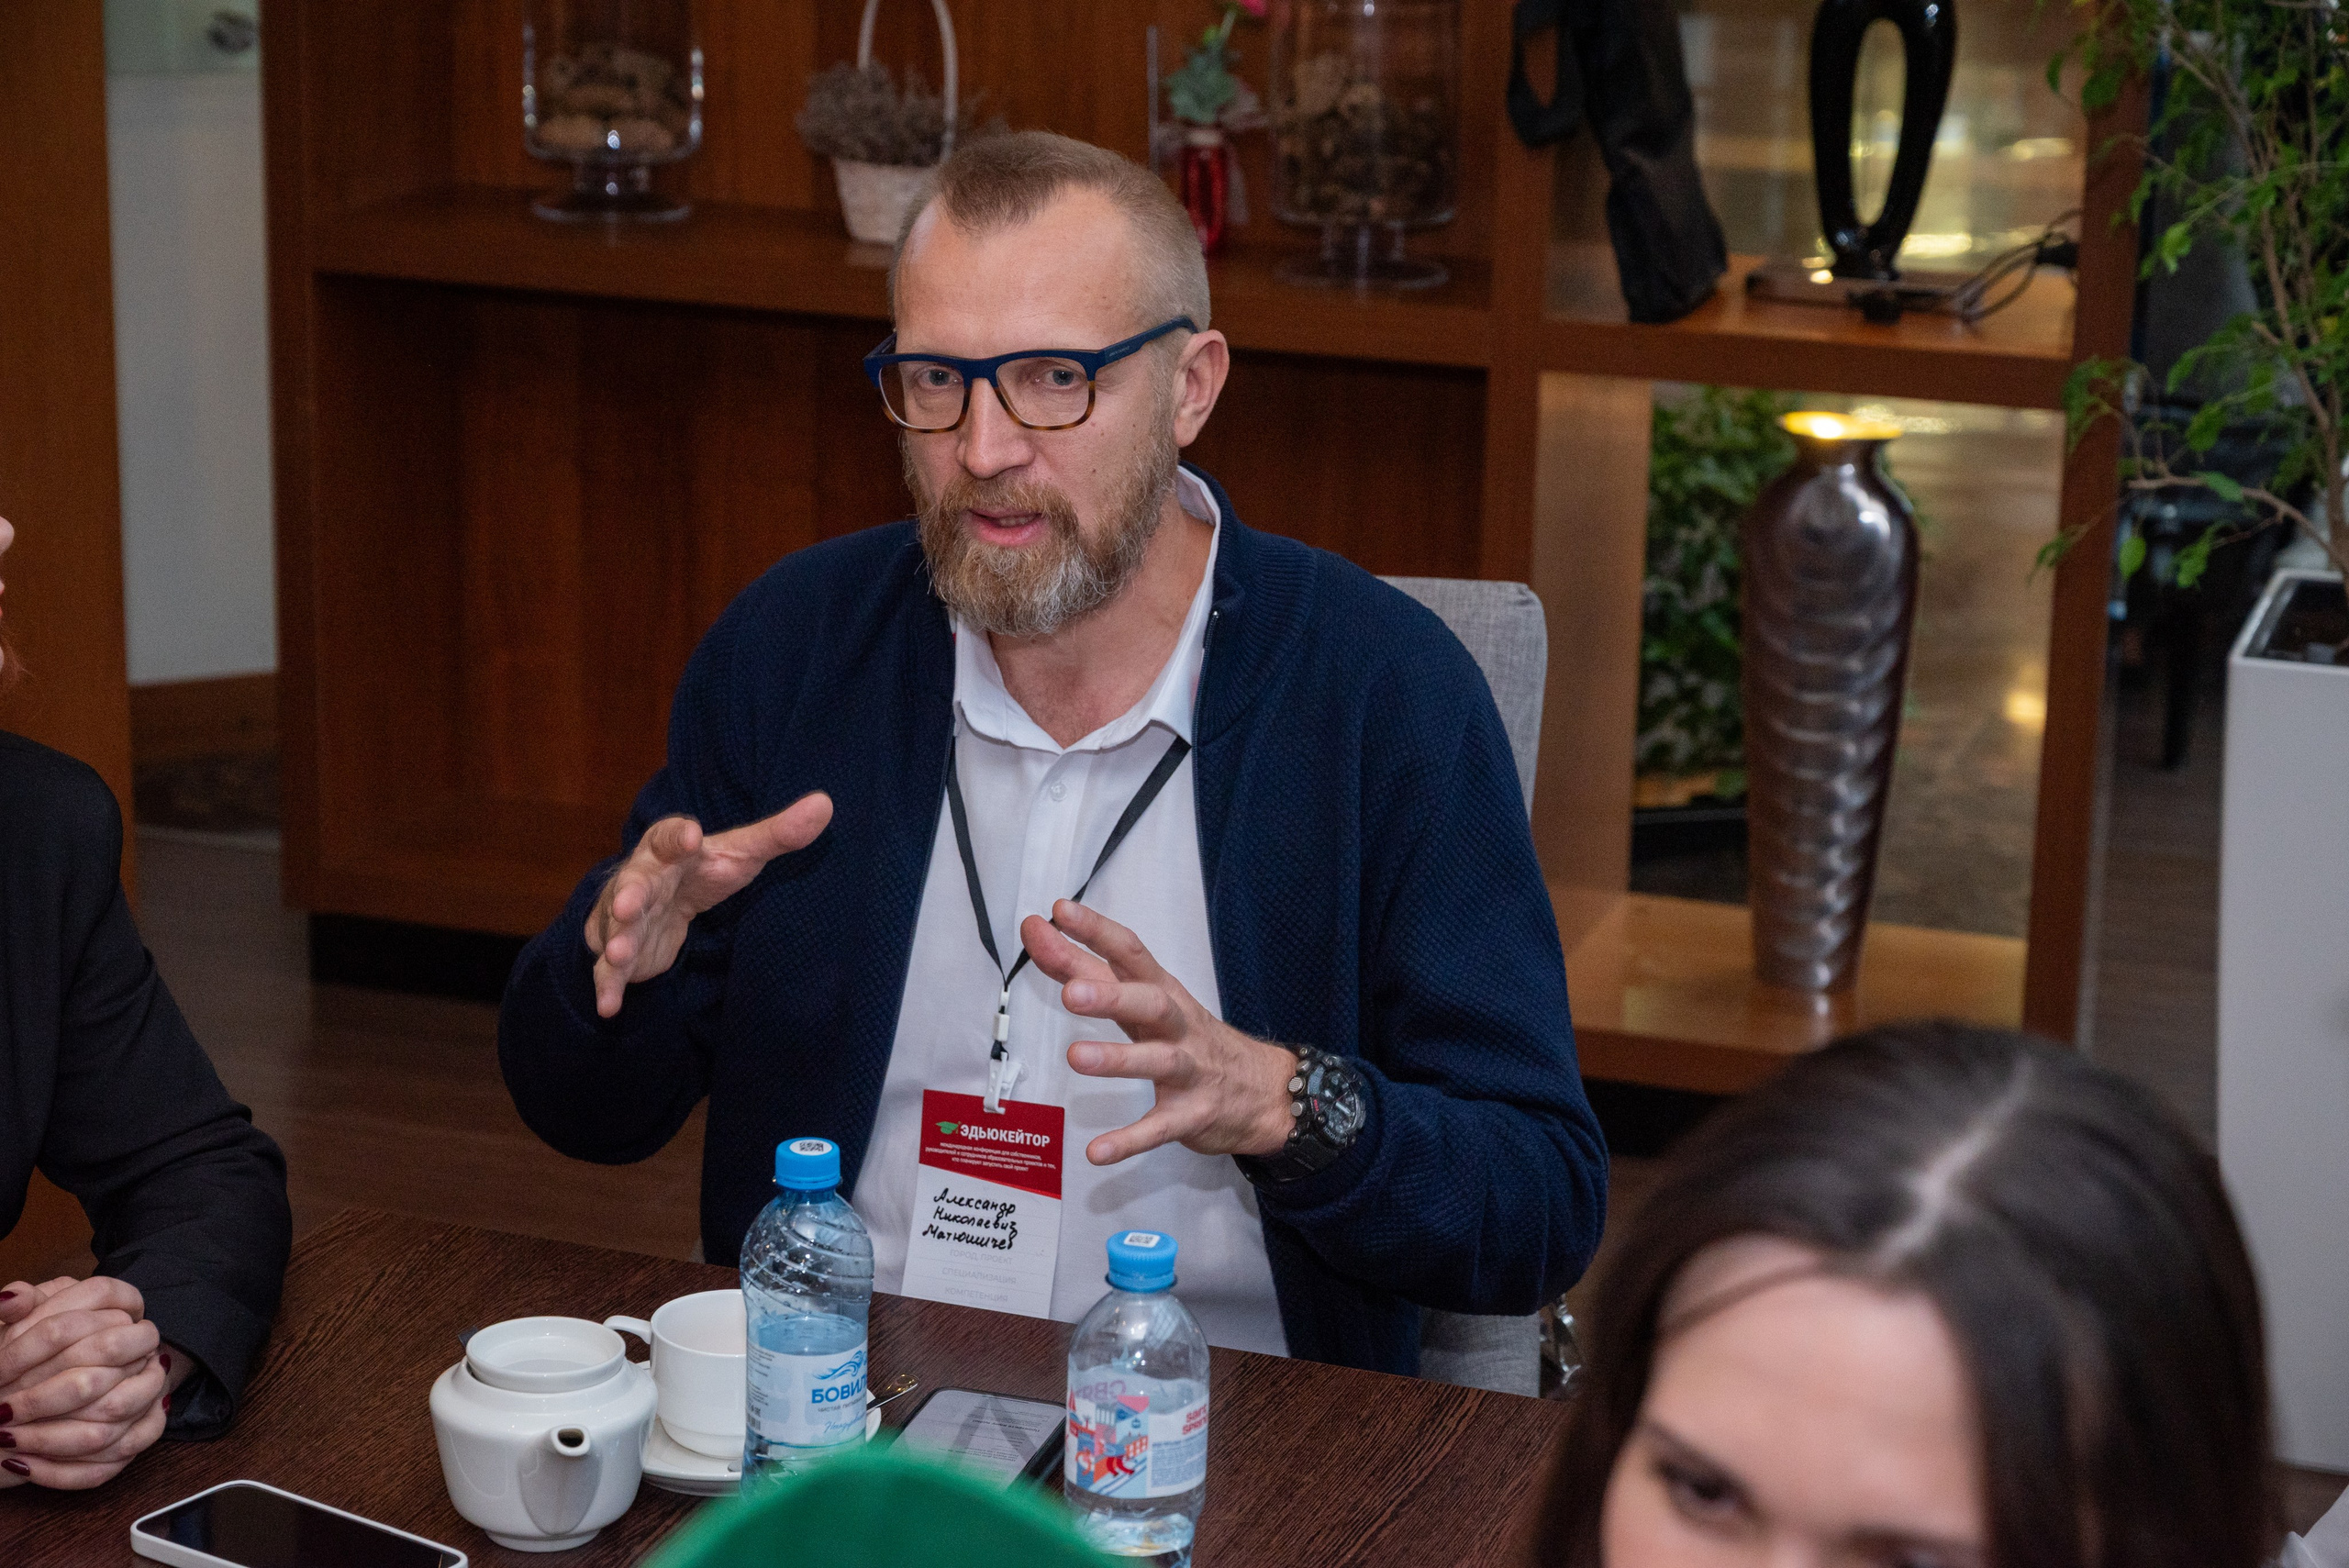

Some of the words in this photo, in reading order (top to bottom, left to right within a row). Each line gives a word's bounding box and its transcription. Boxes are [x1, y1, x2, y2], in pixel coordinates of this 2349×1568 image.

[960, 1124, 1051, 1148] ЭДЬЮКЕЙТОР
[934, 1187, 1016, 1218] Александр
[933, 1206, 1018, 1239] Николаевич
[980, 1253, 1013, 1264] ПРОЕКТ
[941, 1267, 1017, 1284] СПЕЦИАЛИЗАЦИЯ
[945, 1287, 1008, 1302] КОМПЕТЕНЦИЯ
